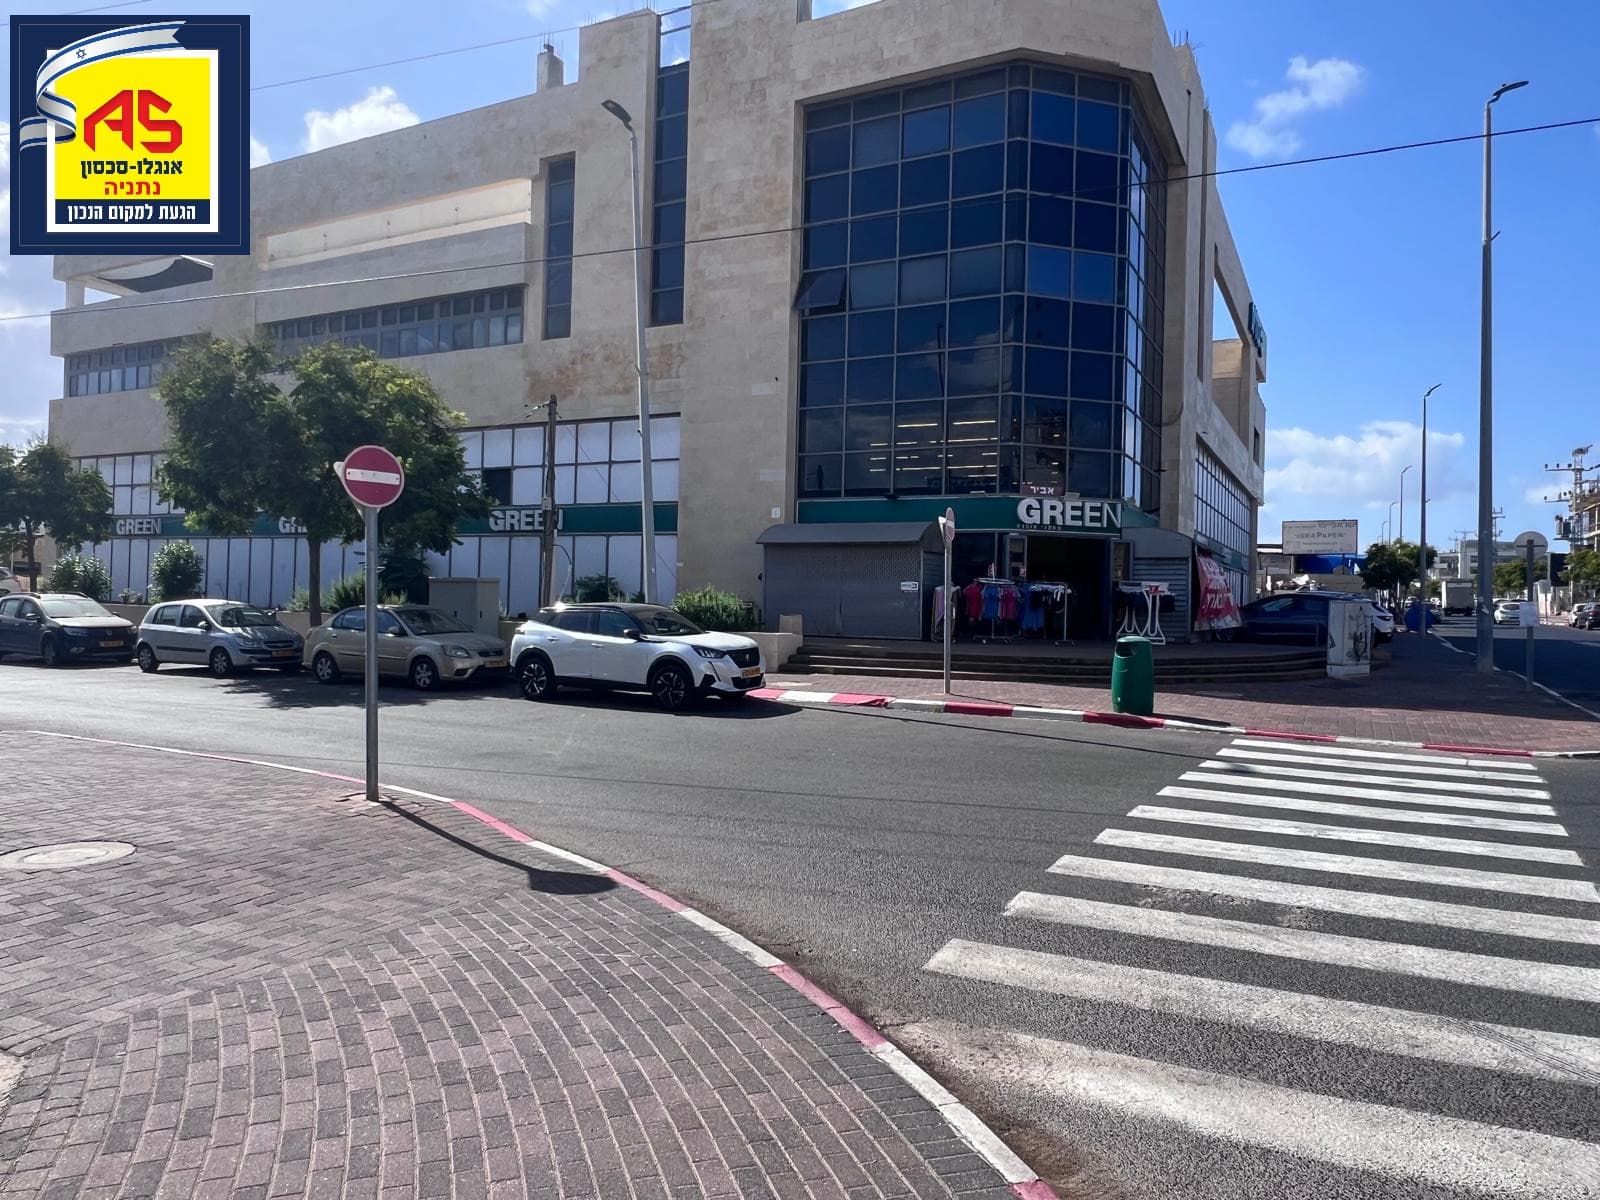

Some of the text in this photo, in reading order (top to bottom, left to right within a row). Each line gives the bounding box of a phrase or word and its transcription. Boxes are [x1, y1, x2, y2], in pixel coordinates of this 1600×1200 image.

[1030, 486, 1054, 495] אביר
[1017, 498, 1122, 532] GREEN
[116, 518, 161, 535] GREEN
